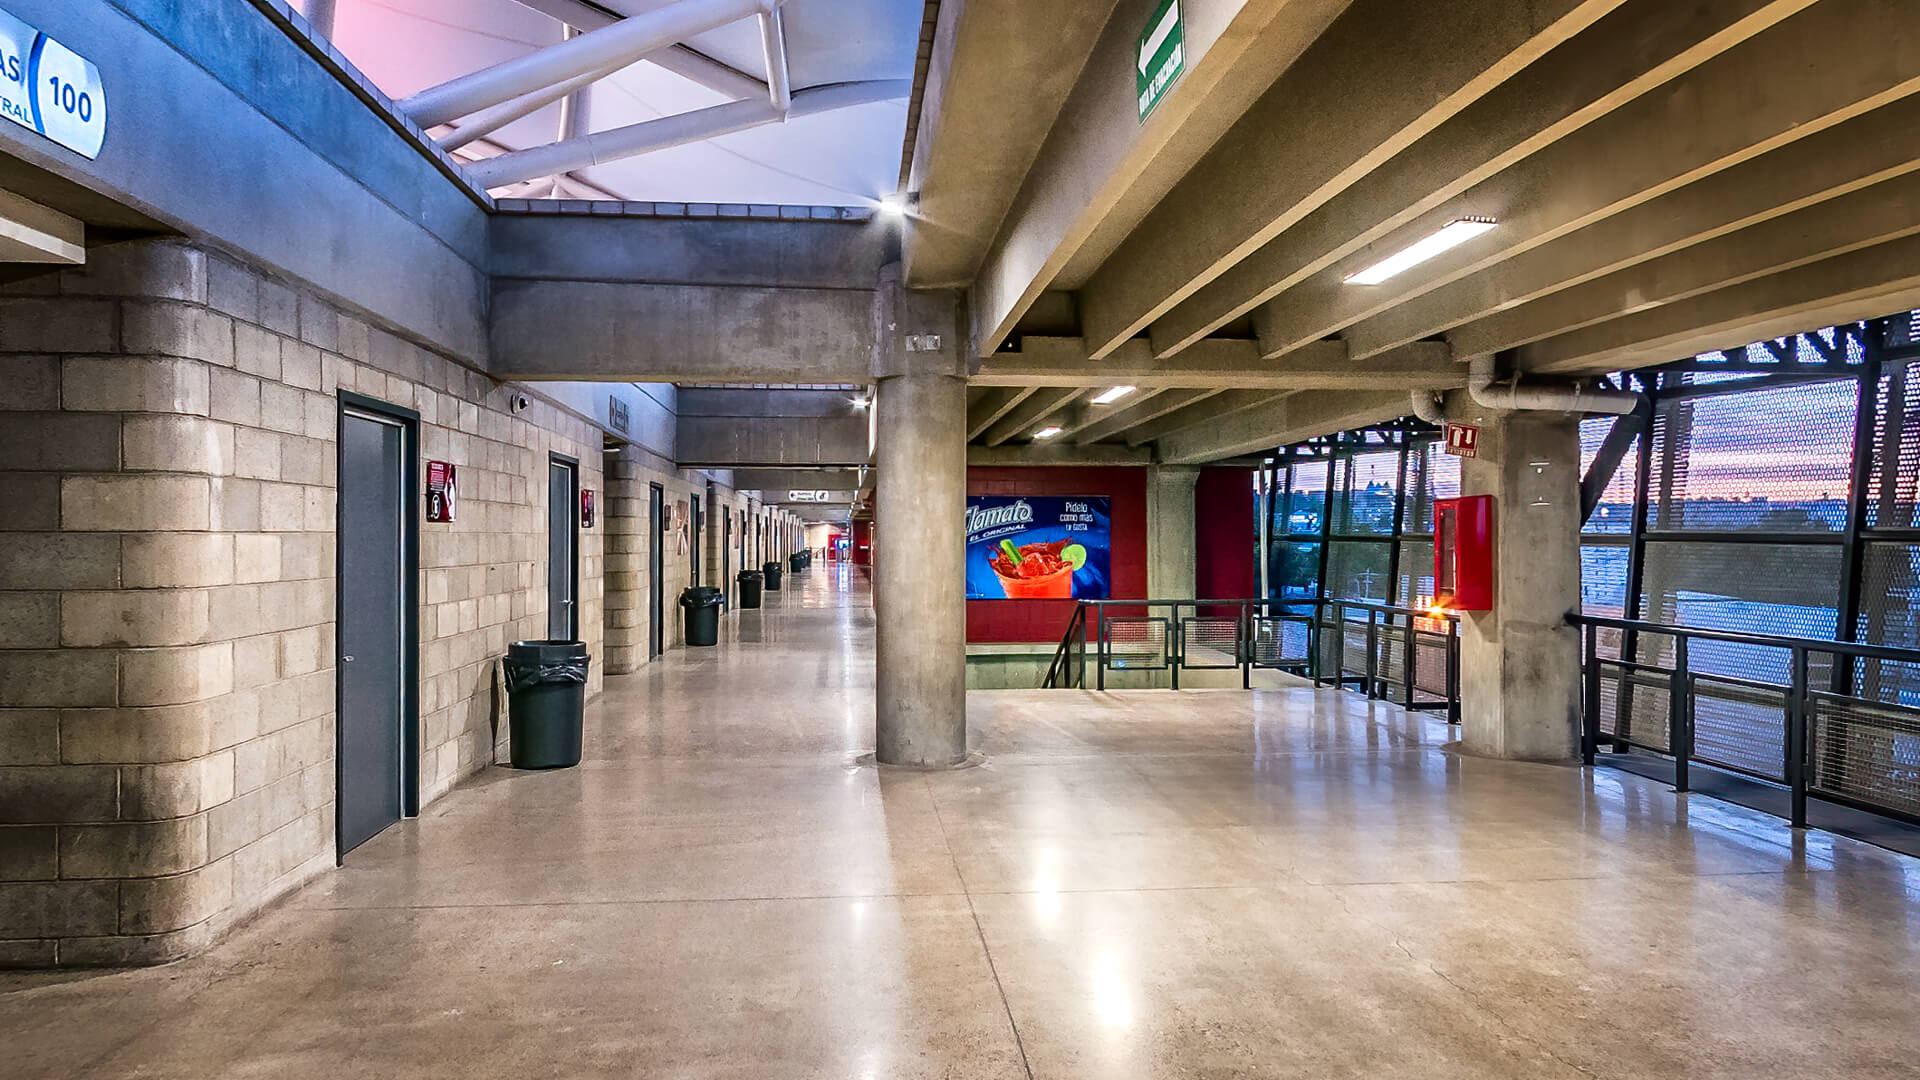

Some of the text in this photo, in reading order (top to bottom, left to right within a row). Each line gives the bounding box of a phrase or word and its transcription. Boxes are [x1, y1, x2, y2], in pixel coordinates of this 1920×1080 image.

[49, 76, 92, 123] 100
[1060, 514, 1078, 522] como
[982, 524, 1026, 538] ORIGINAL
